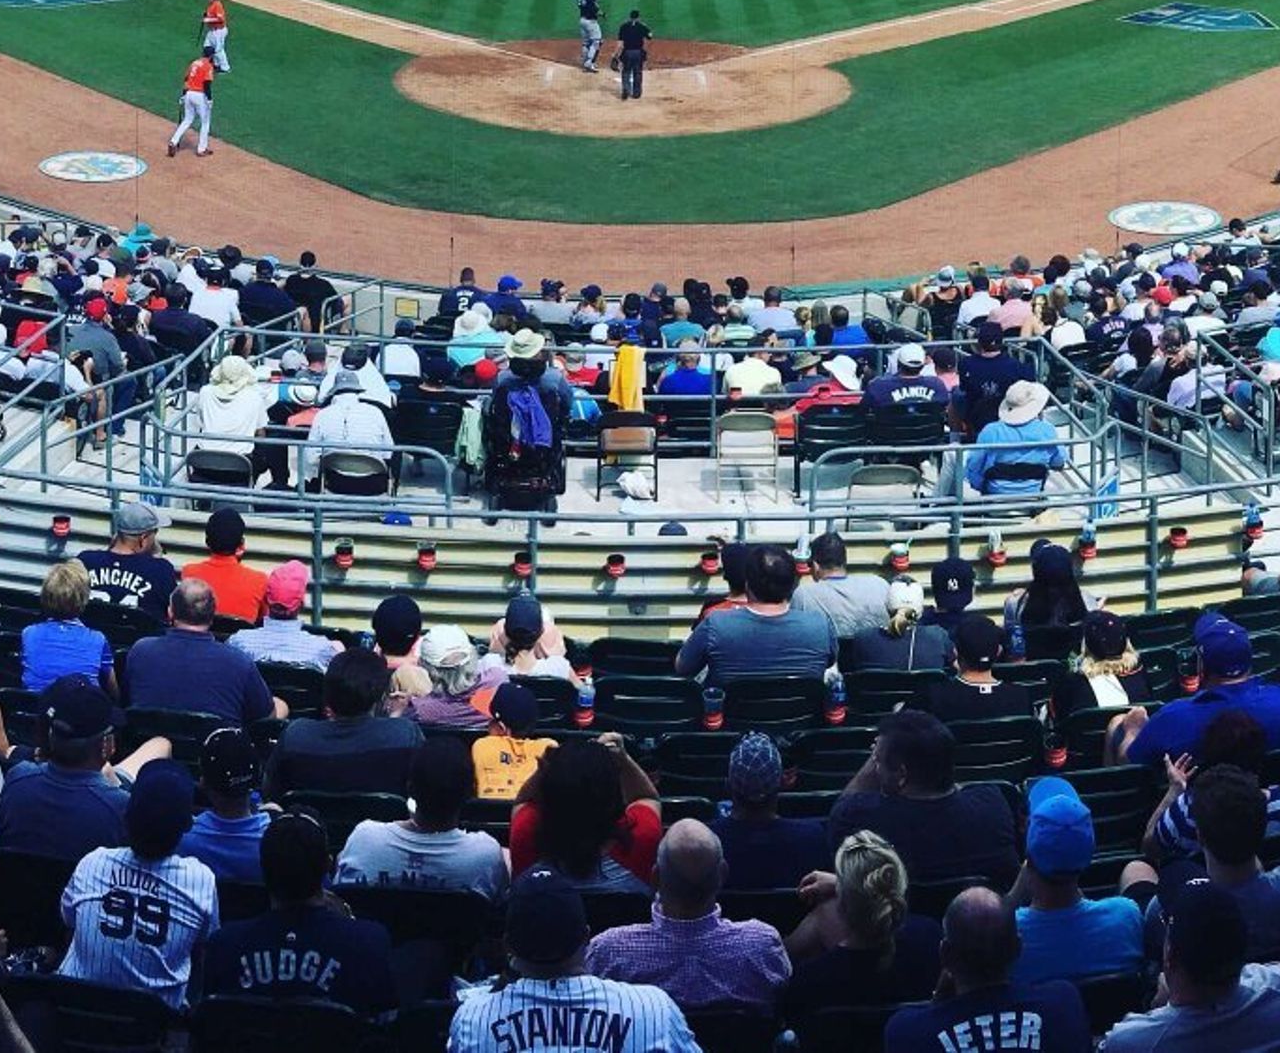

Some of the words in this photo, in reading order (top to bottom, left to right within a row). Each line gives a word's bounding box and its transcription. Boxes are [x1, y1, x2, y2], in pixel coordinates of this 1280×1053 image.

[891, 386, 935, 403] MANTLE
[88, 567, 152, 598] ANCHEZ
[110, 863, 162, 897] JUDGE
[100, 888, 171, 947] 99
[239, 949, 341, 992] JUDGE
[490, 1007, 632, 1053] STANTON
